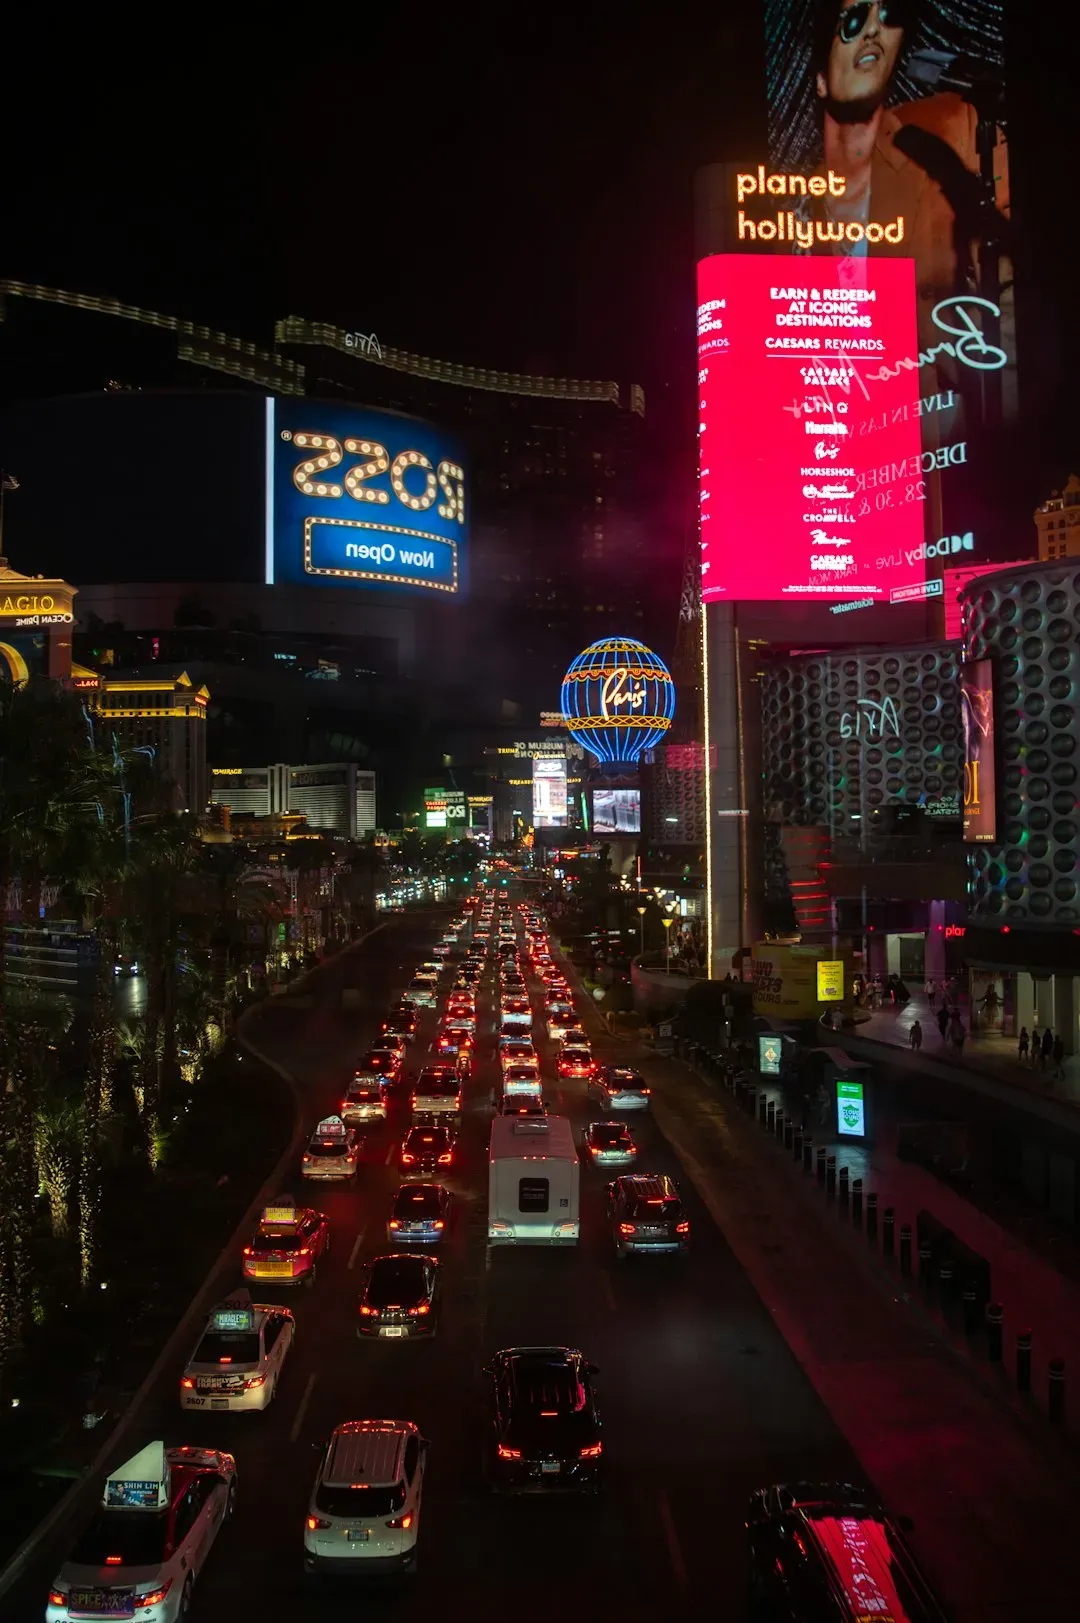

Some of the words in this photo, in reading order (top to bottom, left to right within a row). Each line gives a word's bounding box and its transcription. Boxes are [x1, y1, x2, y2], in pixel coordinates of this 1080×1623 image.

[737, 166, 845, 203] planet
[738, 211, 904, 249] hollywood
[770, 287, 808, 300] EARN
[810, 288, 821, 300] &
[823, 289, 876, 302] REDEEM
[789, 301, 806, 313] AT
[809, 302, 858, 314] ICONIC
[776, 314, 872, 328] DESTINATIONS
[765, 337, 821, 349] CAESARS
[800, 367, 855, 378] CAESARS
[804, 376, 851, 386] PALACE
[804, 402, 849, 413] LINQ
[800, 467, 856, 477] HORSESHOE
[802, 514, 856, 523] CROMWELL
[810, 555, 854, 565] CAESARS
[2, 596, 54, 612] AGIO
[601, 667, 647, 721] Paris
[124, 1482, 143, 1490] SHIN
[71, 1592, 101, 1606] SPICE
